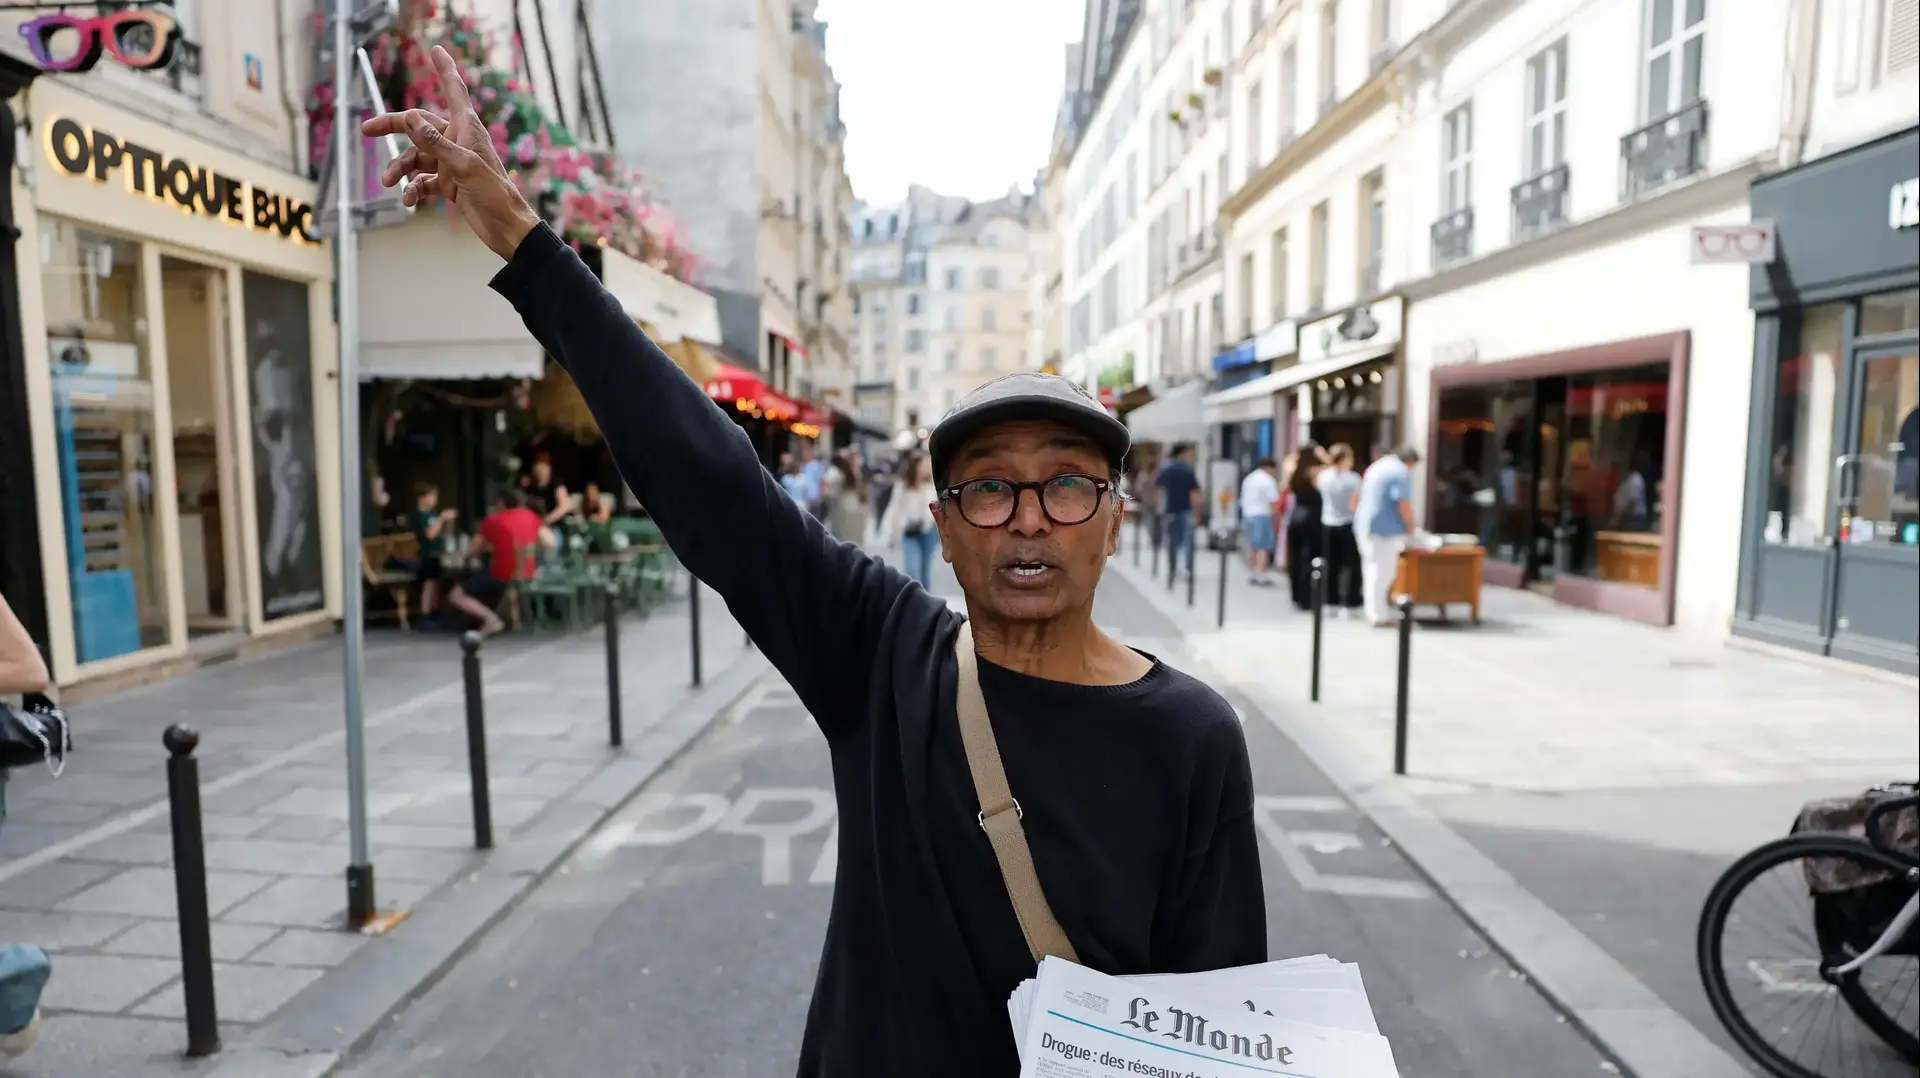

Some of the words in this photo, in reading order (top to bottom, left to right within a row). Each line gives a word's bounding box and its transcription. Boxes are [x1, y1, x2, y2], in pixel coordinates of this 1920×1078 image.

[51, 118, 244, 222] OPTIQUE
[1041, 1032, 1091, 1061] Drogue
[1100, 1051, 1125, 1070] des
[1127, 1059, 1182, 1078] réseaux
[1120, 997, 1160, 1033] Le
[1162, 1006, 1294, 1066] Monde
